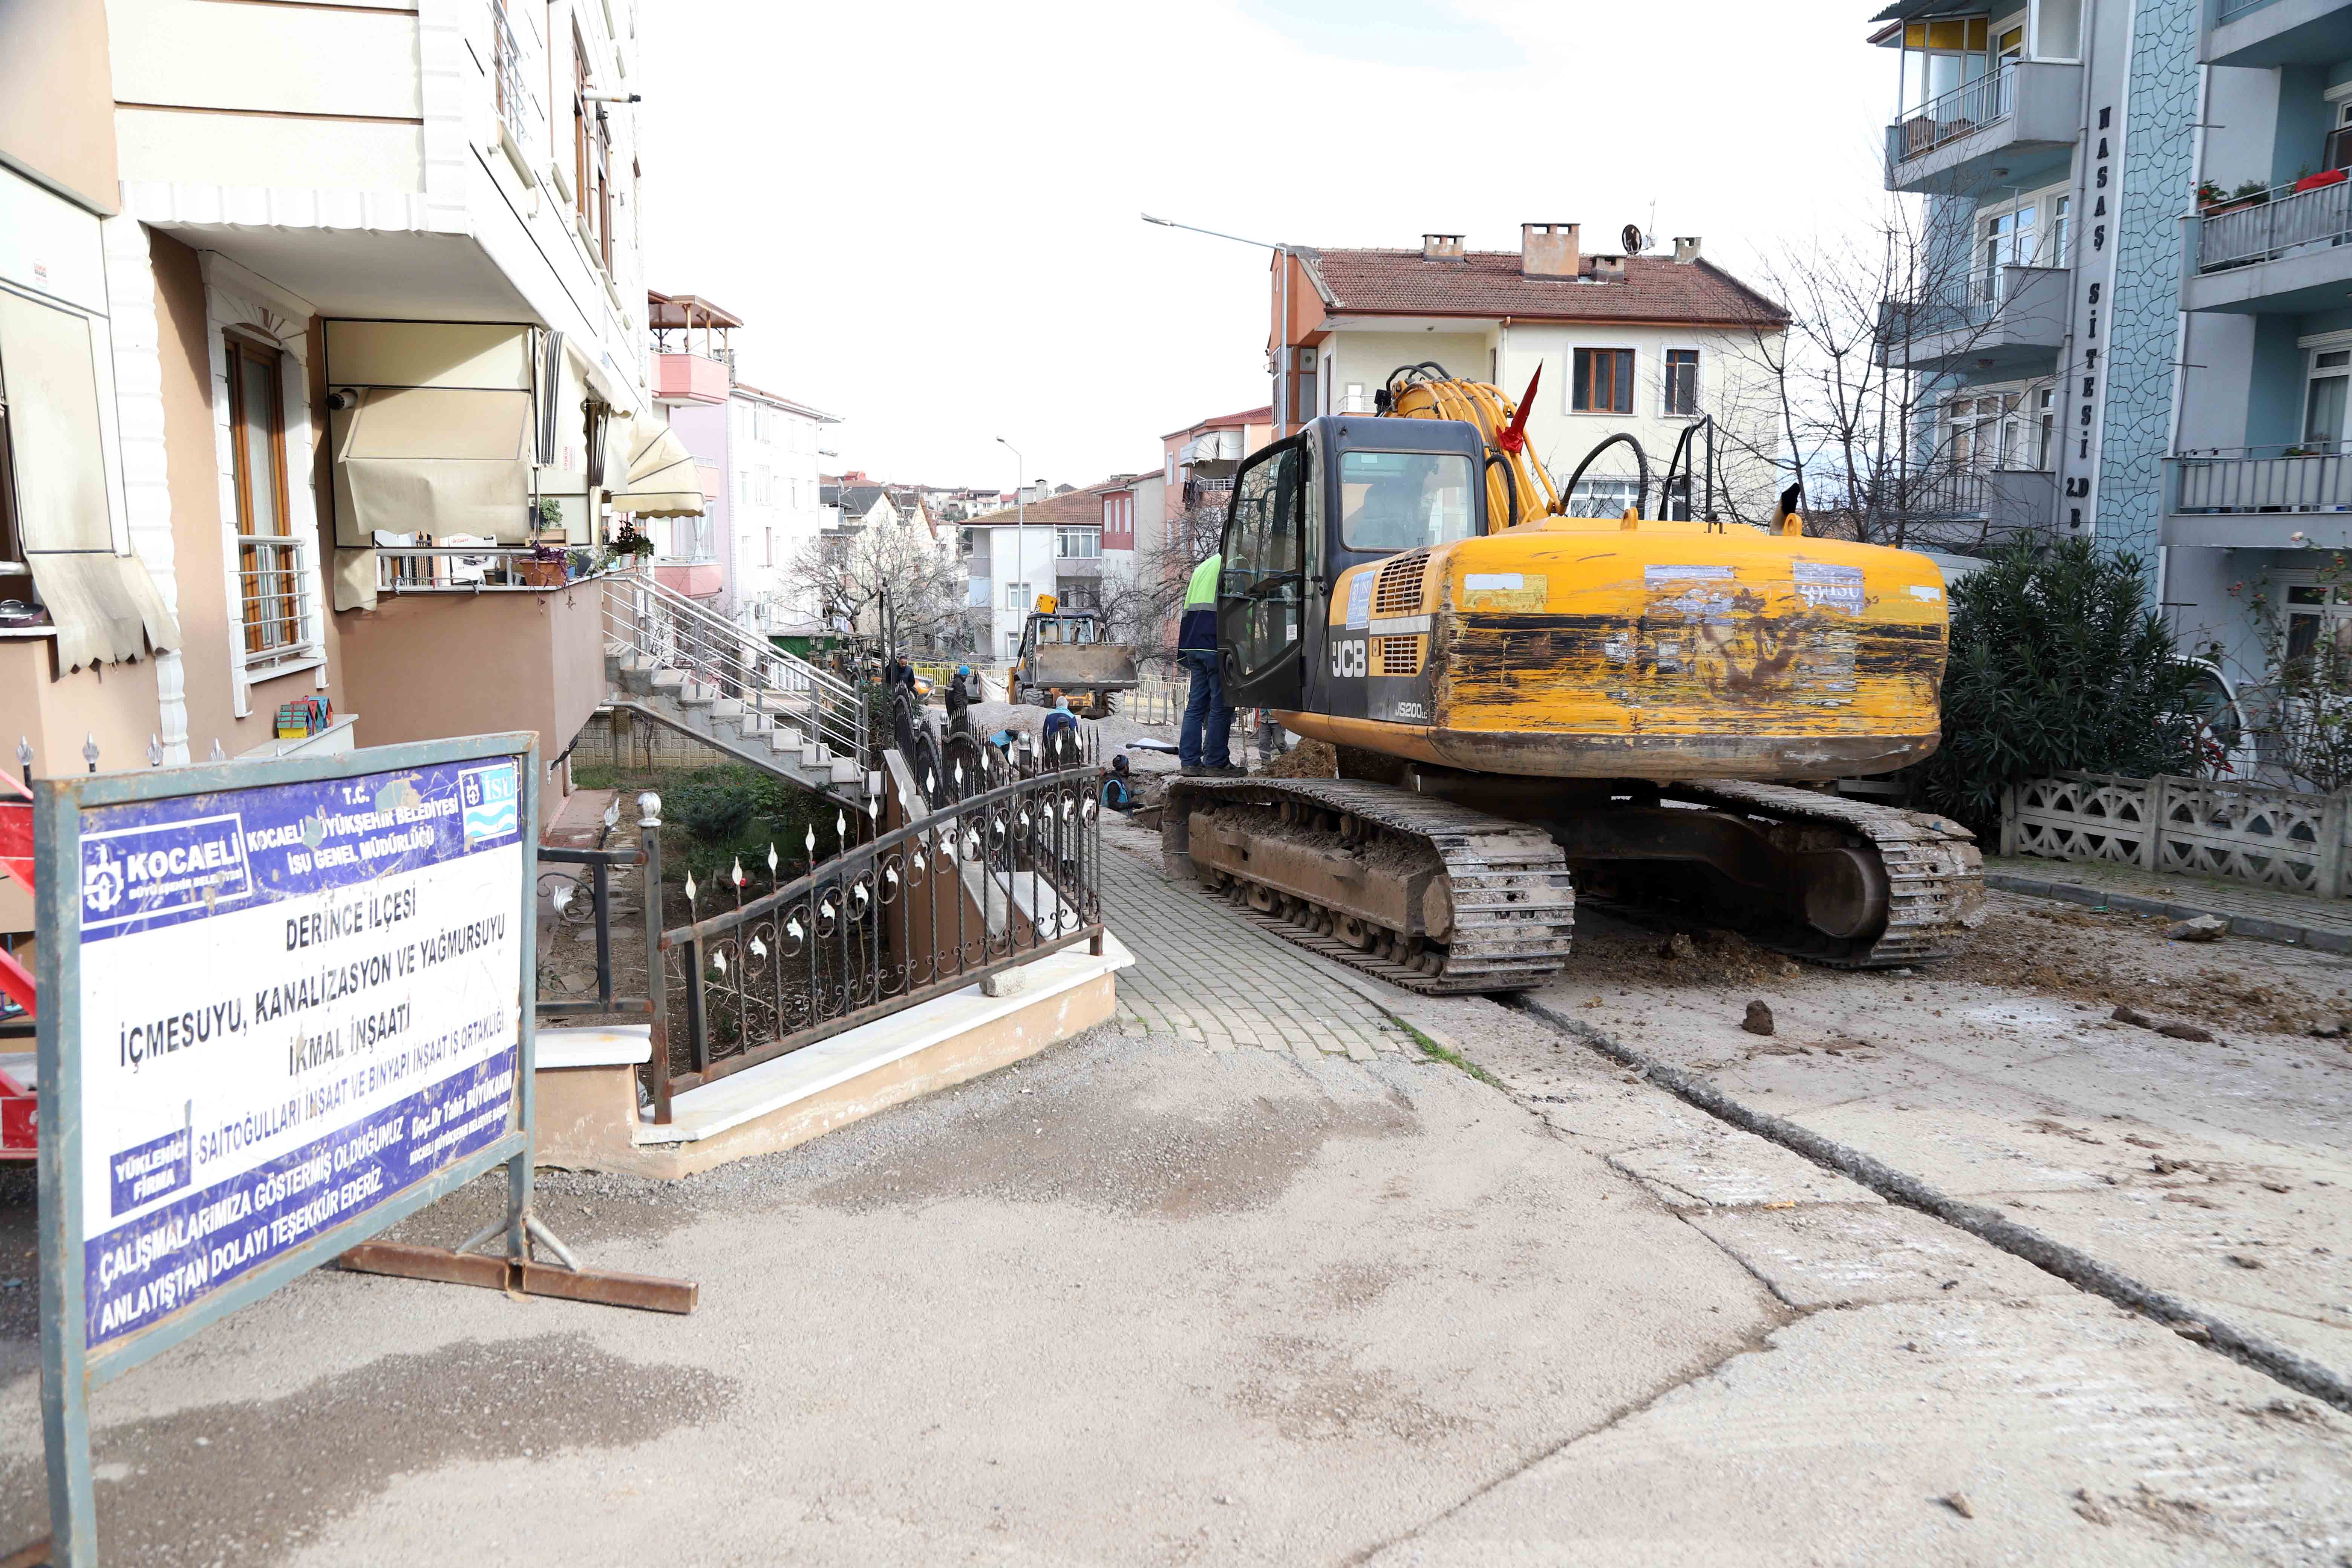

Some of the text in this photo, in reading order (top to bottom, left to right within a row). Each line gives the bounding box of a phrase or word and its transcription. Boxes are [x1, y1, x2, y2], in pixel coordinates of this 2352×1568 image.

[2079, 283, 2100, 459] SİTESİ
[1333, 640, 1366, 677] JCB
[342, 786, 370, 805] T.C.
[484, 773, 514, 801] İSU
[247, 793, 459, 852] KOCAELİ ÜYÜKŞEHİR BELEDİYESİ
[287, 824, 435, 875] İSU GENEL MÜDÜRLÜĞÜ
[127, 832, 242, 882] KOCAELİ
[287, 879, 415, 952] DERİNCE İLÇESİ
[121, 913, 505, 1074] İÇMESUYU, KANALİZASYON VE YAĞMURSUYU
[290, 1002, 410, 1076] İKMAL İNŞAATI
[306, 1078, 348, 1122] İNŞAAT
[352, 1070, 365, 1100] VE
[413, 1035, 447, 1075] İNŞAAT
[461, 1006, 504, 1050] ORTAKLIĞI
[443, 1095, 466, 1123] Tahir
[466, 1069, 512, 1112] BÜYÜKAKIN
[115, 1135, 187, 1184] YÜKLENİCİ
[254, 1147, 332, 1211] GÖSTERMİŞ
[334, 1116, 404, 1173] OLDUĞUNUZ
[409, 1141, 433, 1166] KOCAELİ
[133, 1168, 176, 1202] FİRMA
[100, 1164, 384, 1335] ANLAYIŞTAN DOLAYI TEŞEKKÜR EDERİZ.
